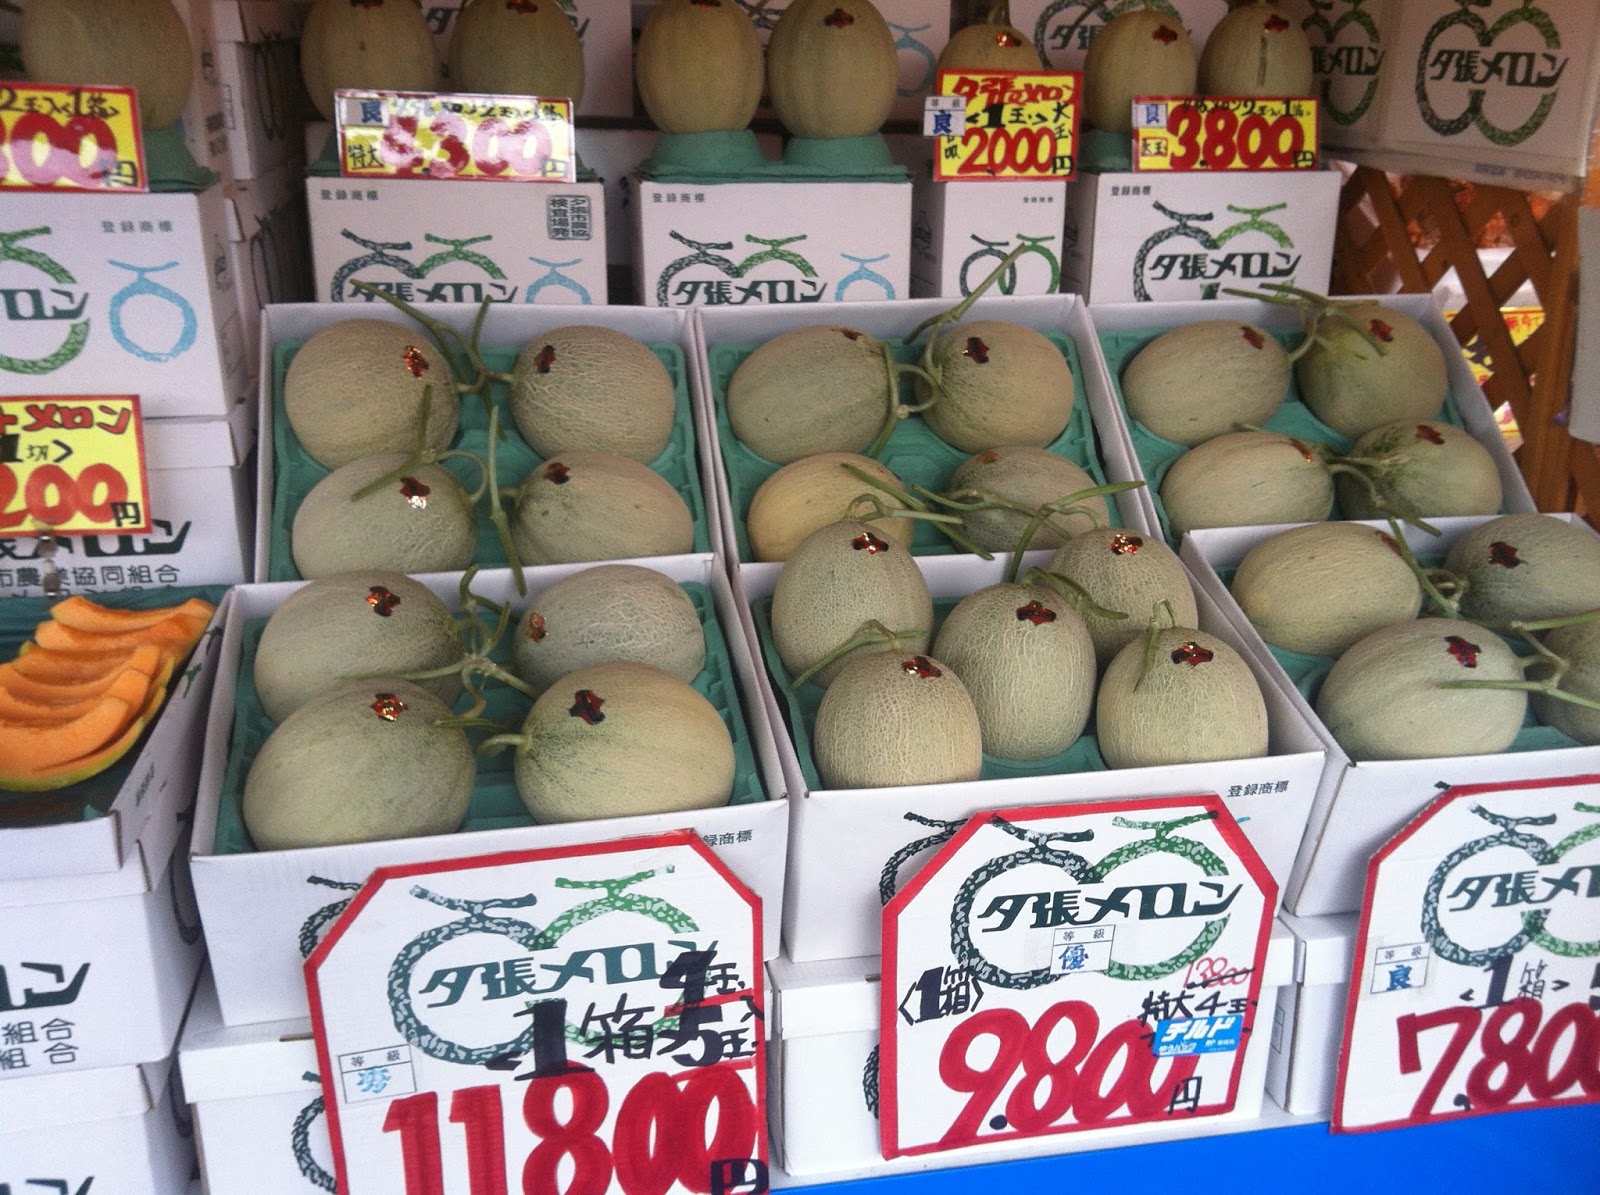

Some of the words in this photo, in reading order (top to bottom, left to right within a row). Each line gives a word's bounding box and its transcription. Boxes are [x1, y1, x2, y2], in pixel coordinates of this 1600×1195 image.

[1430, 49, 1570, 88] 夕張メロン
[933, 110, 952, 134] 良
[1150, 252, 1302, 280] 夕張メロン
[672, 280, 828, 305] 夕張メロン
[1227, 780, 1289, 798] 登録商標
[977, 883, 1244, 933] 夕張メロン
[1062, 928, 1105, 941] 等級
[1058, 943, 1089, 970] 優
[1386, 964, 1412, 991] 良
[1160, 1016, 1236, 1043] チルド
